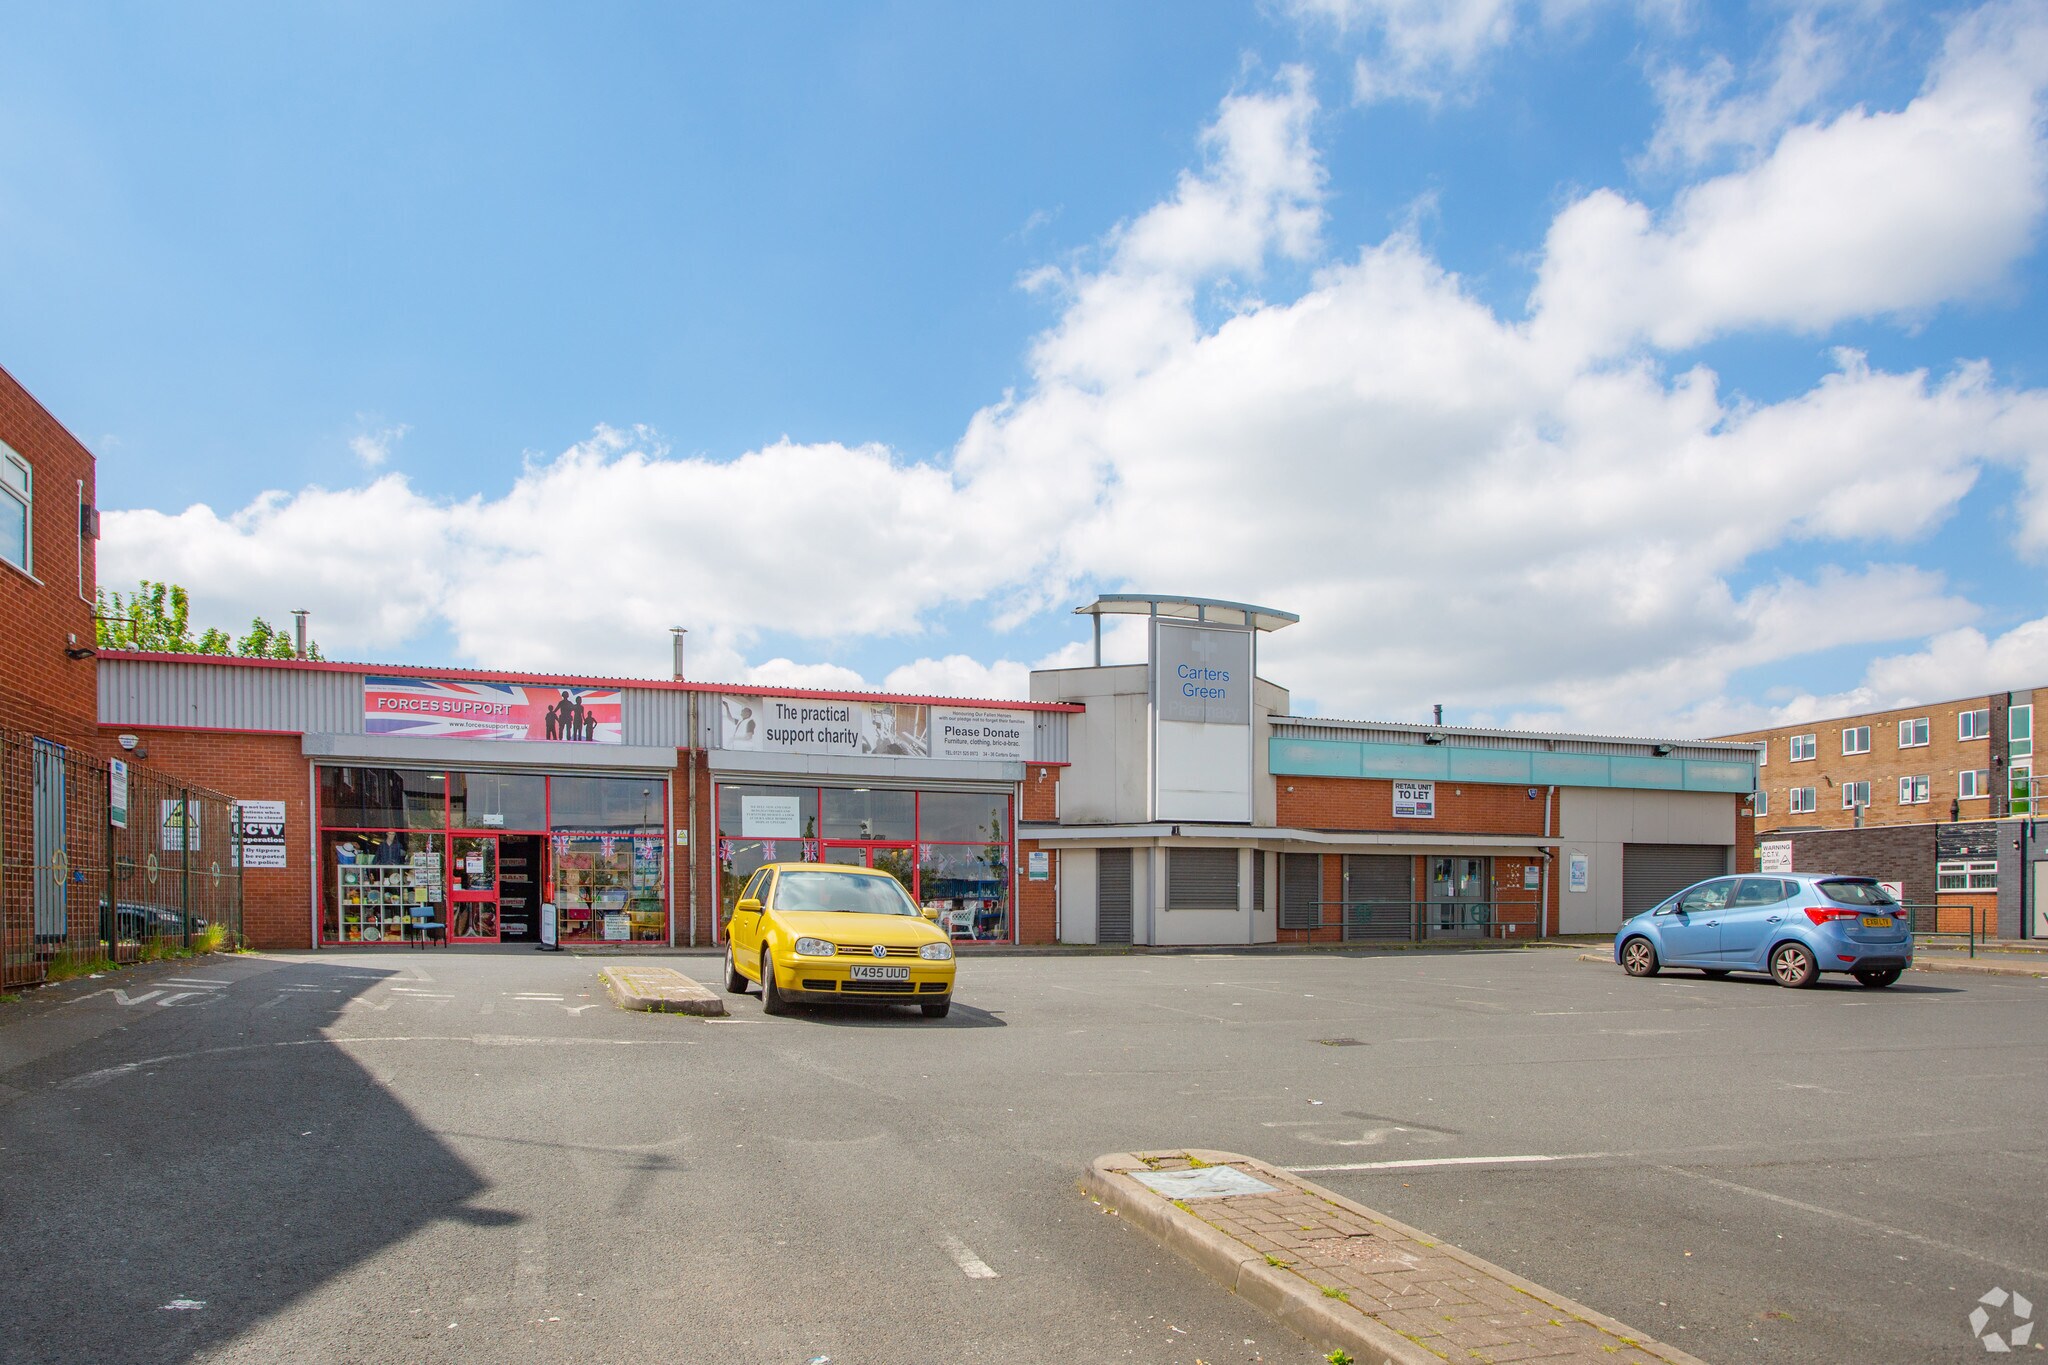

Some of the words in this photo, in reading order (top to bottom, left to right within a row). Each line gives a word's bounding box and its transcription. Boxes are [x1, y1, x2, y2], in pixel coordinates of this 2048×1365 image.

[1177, 664, 1230, 682] Carters
[1182, 683, 1225, 699] Green
[377, 698, 439, 711] FORCES
[442, 702, 512, 715] SUPPORT
[776, 703, 798, 720] The
[801, 707, 850, 723] practical
[449, 722, 529, 730] www.forcessupport.org.uk
[944, 725, 980, 737] Please
[983, 727, 1020, 739] Donate
[766, 728, 815, 746] support
[818, 727, 859, 748] charity
[944, 738, 969, 746] Furniture,
[970, 739, 991, 747] clothing,
[1398, 790, 1411, 799] TO
[1413, 791, 1430, 800] LET
[854, 967, 884, 978] V495
[886, 968, 908, 978] UUD
